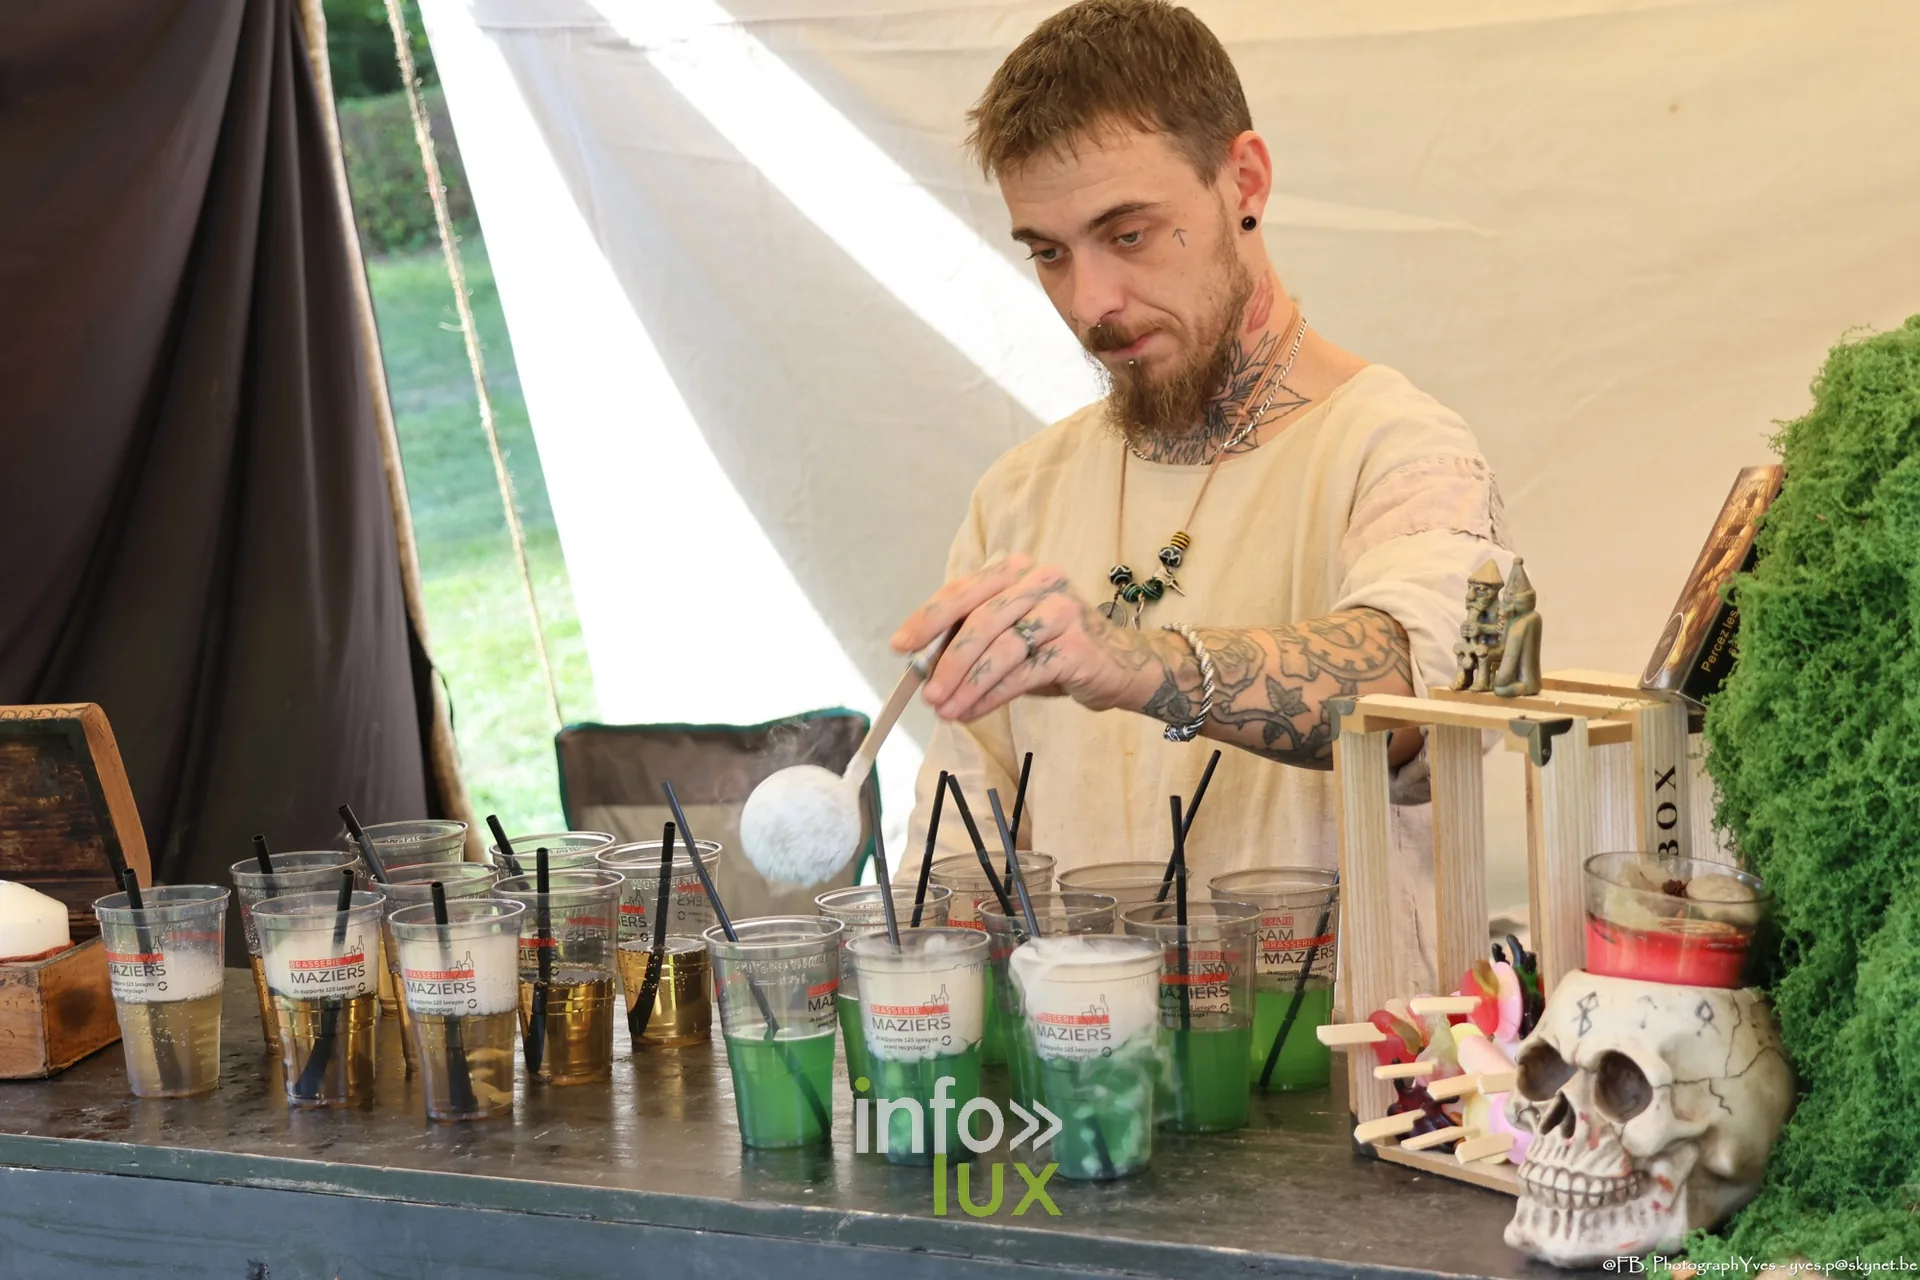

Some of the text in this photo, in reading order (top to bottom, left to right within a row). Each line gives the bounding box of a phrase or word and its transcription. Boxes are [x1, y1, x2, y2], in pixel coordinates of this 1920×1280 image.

[1700, 610, 1739, 673] Percez les
[289, 959, 342, 969] BRASSERIE
[290, 965, 366, 984] MAZIERS
[407, 981, 477, 994] MAZIERS
[872, 1016, 951, 1032] MAZIERS
[1036, 1024, 1111, 1041] MAZIERS
